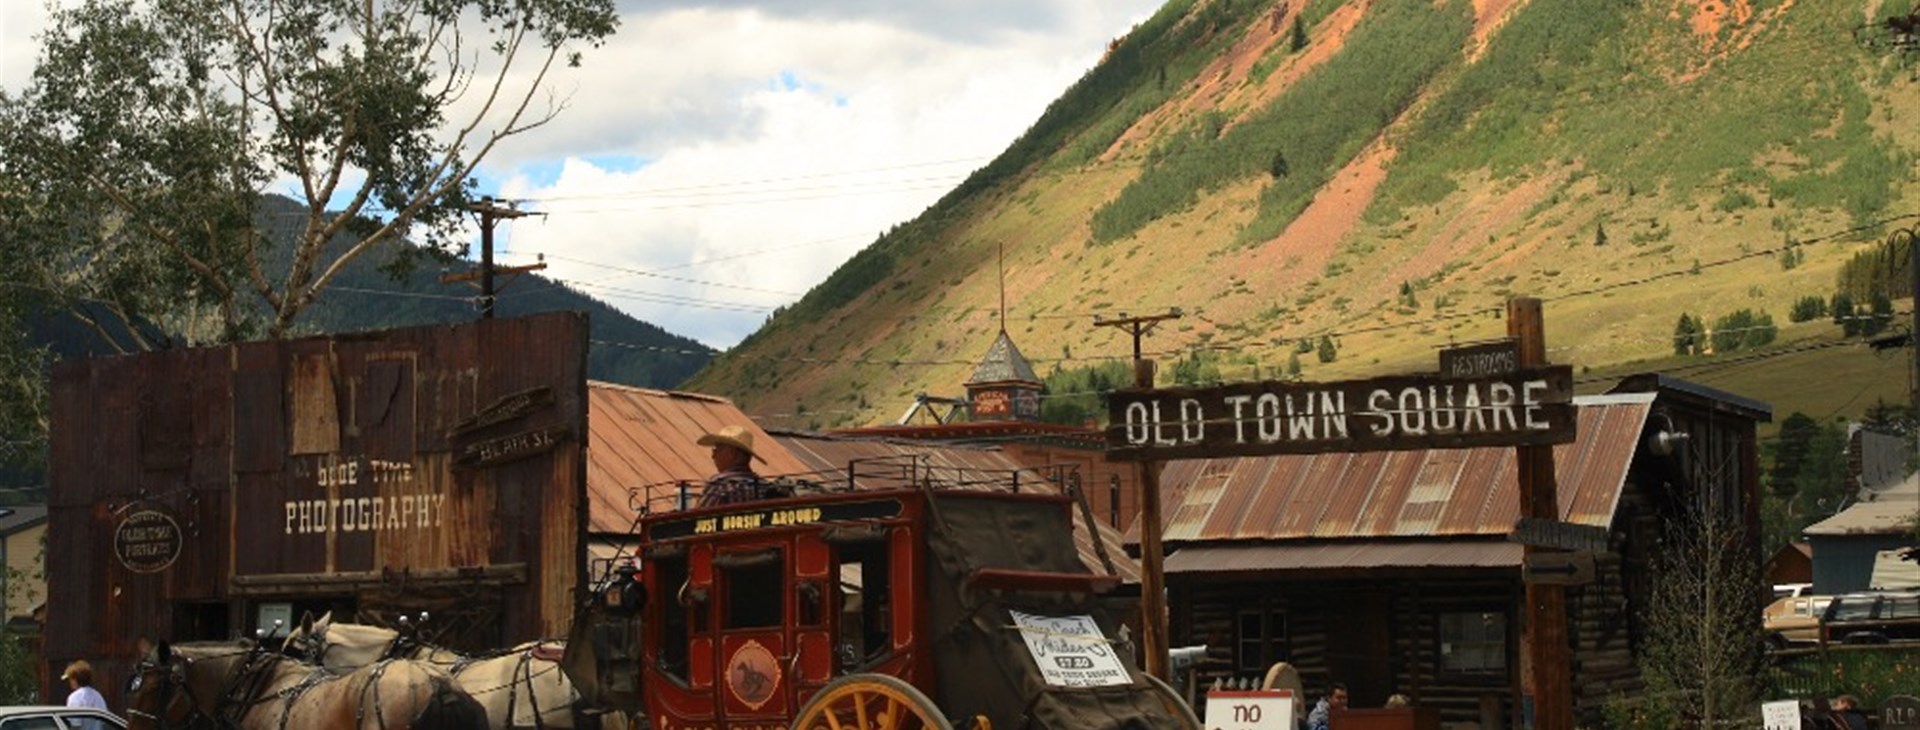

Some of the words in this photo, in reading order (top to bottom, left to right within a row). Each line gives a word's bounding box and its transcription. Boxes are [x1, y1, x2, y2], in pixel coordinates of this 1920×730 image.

[1126, 399, 1205, 447] OLD
[1224, 390, 1348, 444] TOWN
[1368, 379, 1550, 437] SQUARE
[285, 493, 445, 534] PHOTOGRAPHY
[694, 518, 718, 534] JUST
[722, 514, 766, 531] HORSIN'
[771, 508, 822, 526] AROUND
